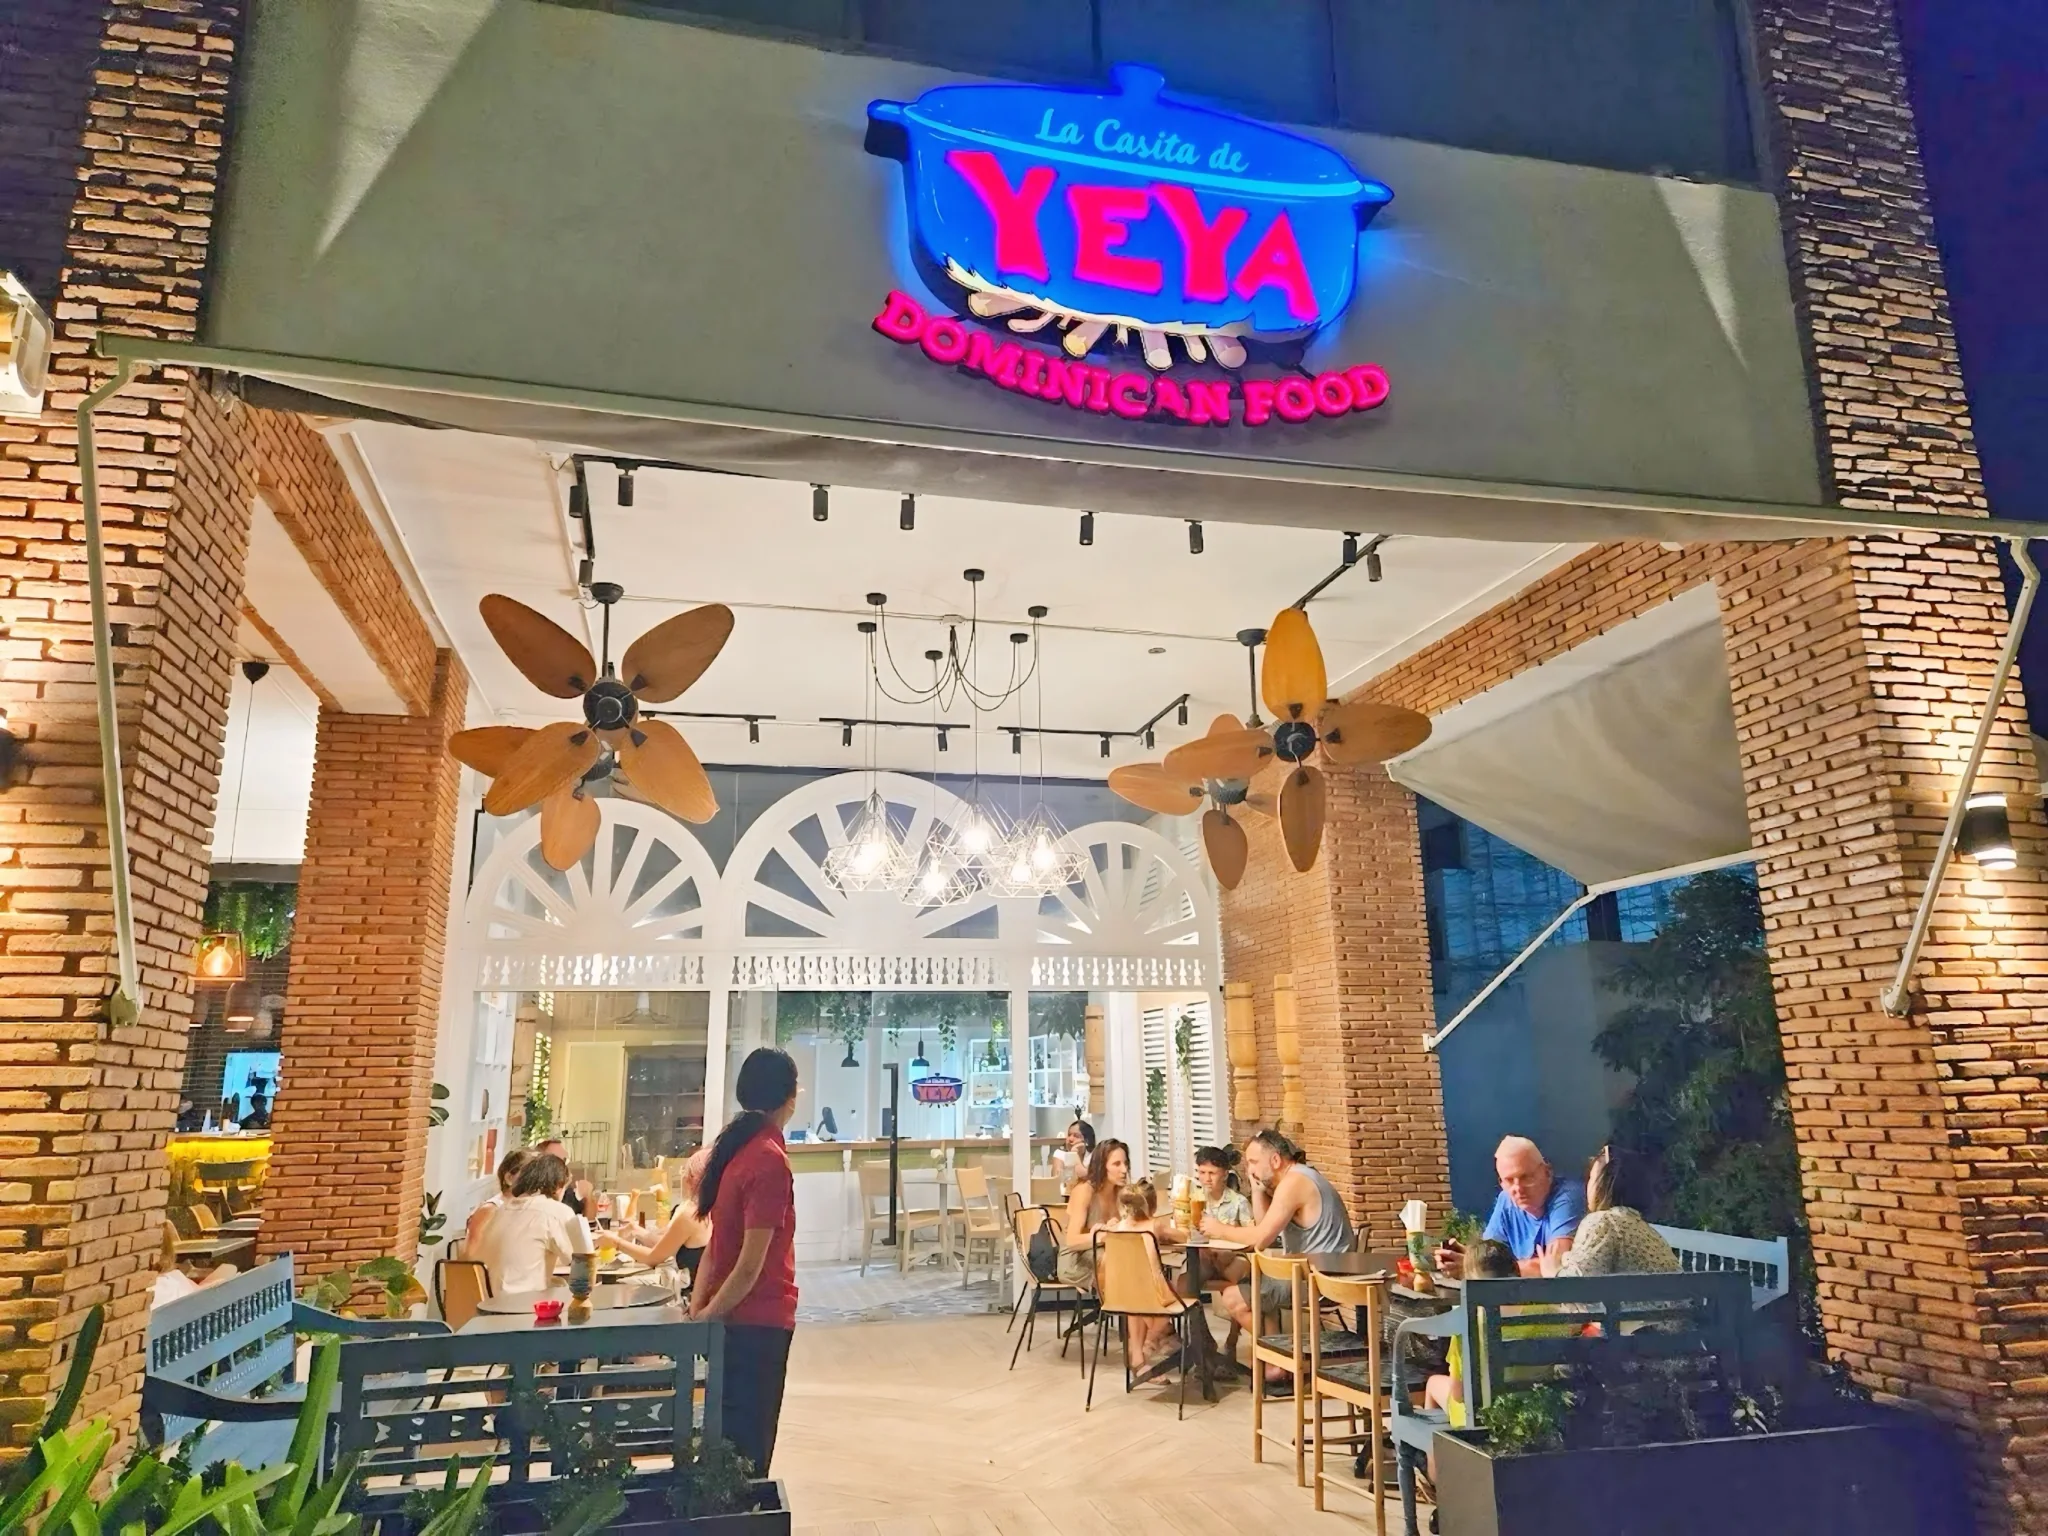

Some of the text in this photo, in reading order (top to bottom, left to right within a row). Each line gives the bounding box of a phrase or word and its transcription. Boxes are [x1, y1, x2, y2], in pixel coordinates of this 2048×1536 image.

[1035, 107, 1250, 174] La Casita de
[944, 149, 1321, 322] YEYA
[871, 289, 1392, 427] DOMINICAN FOOD
